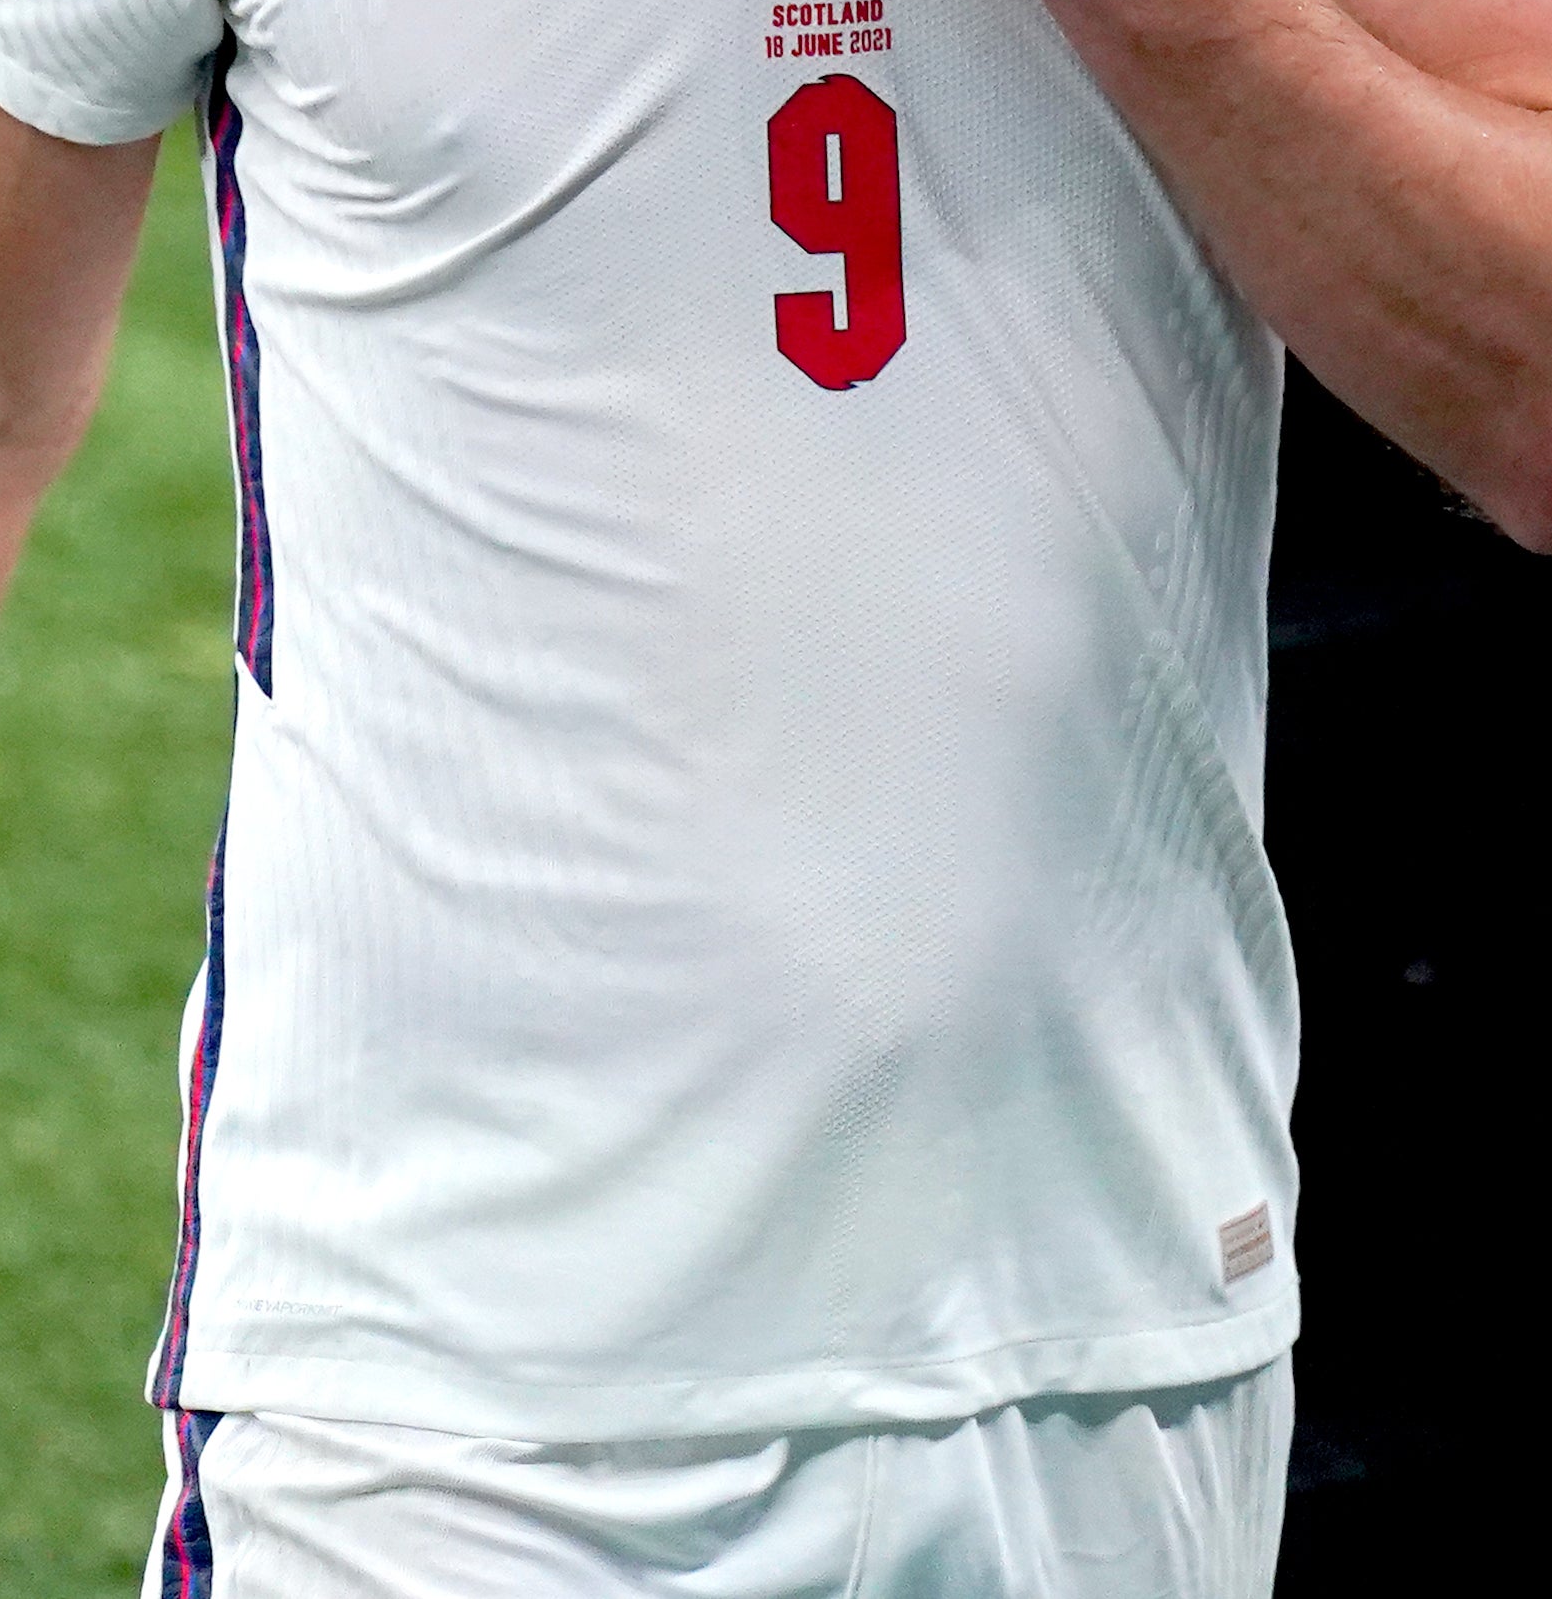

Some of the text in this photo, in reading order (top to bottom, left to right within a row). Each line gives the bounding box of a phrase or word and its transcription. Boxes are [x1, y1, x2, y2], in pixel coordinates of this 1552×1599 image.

[772, 0, 883, 27] SCOTLAND
[765, 28, 892, 58] 18 JUNE 2021
[768, 73, 907, 391] 9
